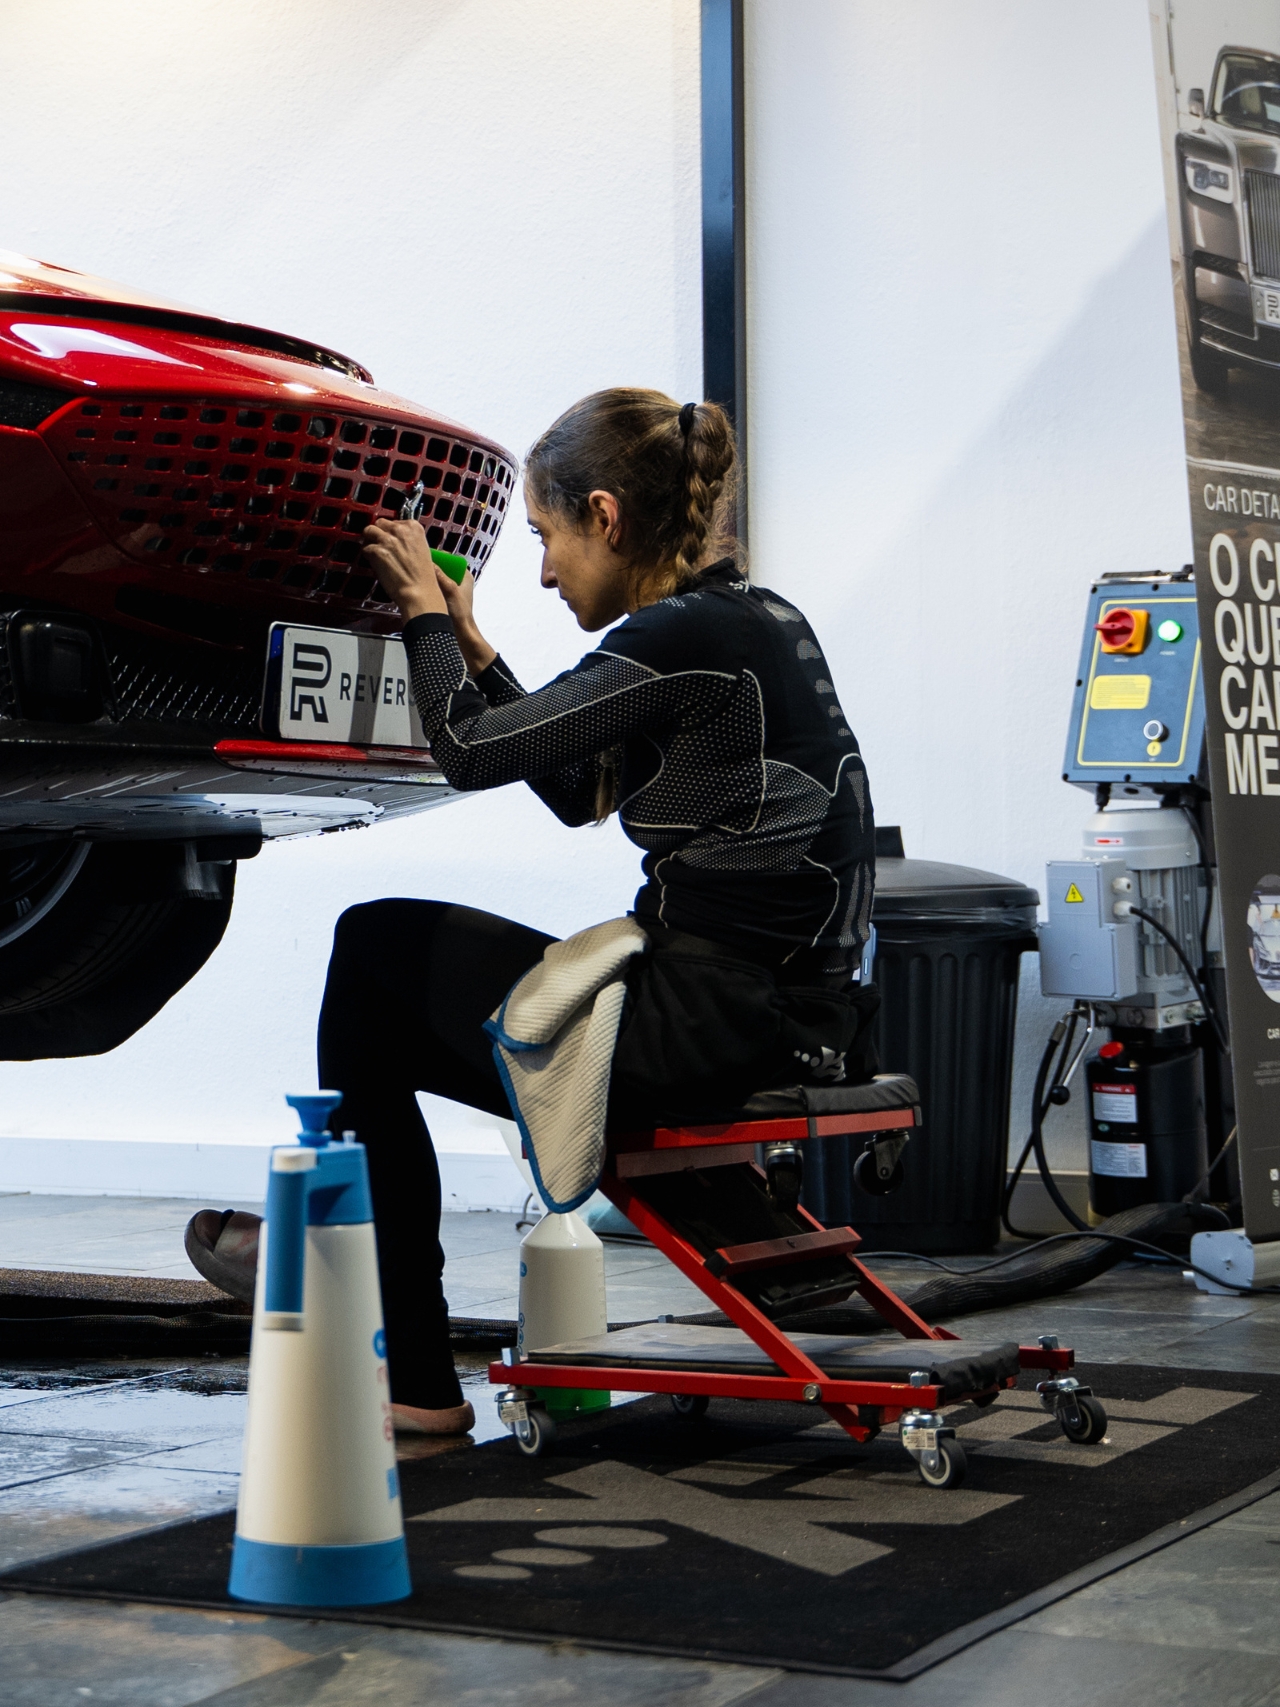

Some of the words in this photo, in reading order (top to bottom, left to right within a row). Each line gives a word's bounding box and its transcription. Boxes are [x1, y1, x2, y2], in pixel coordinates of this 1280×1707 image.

[1203, 483, 1238, 513] CAR
[1209, 533, 1240, 597] O
[339, 672, 415, 706] REVER
[1224, 733, 1280, 796] ME
